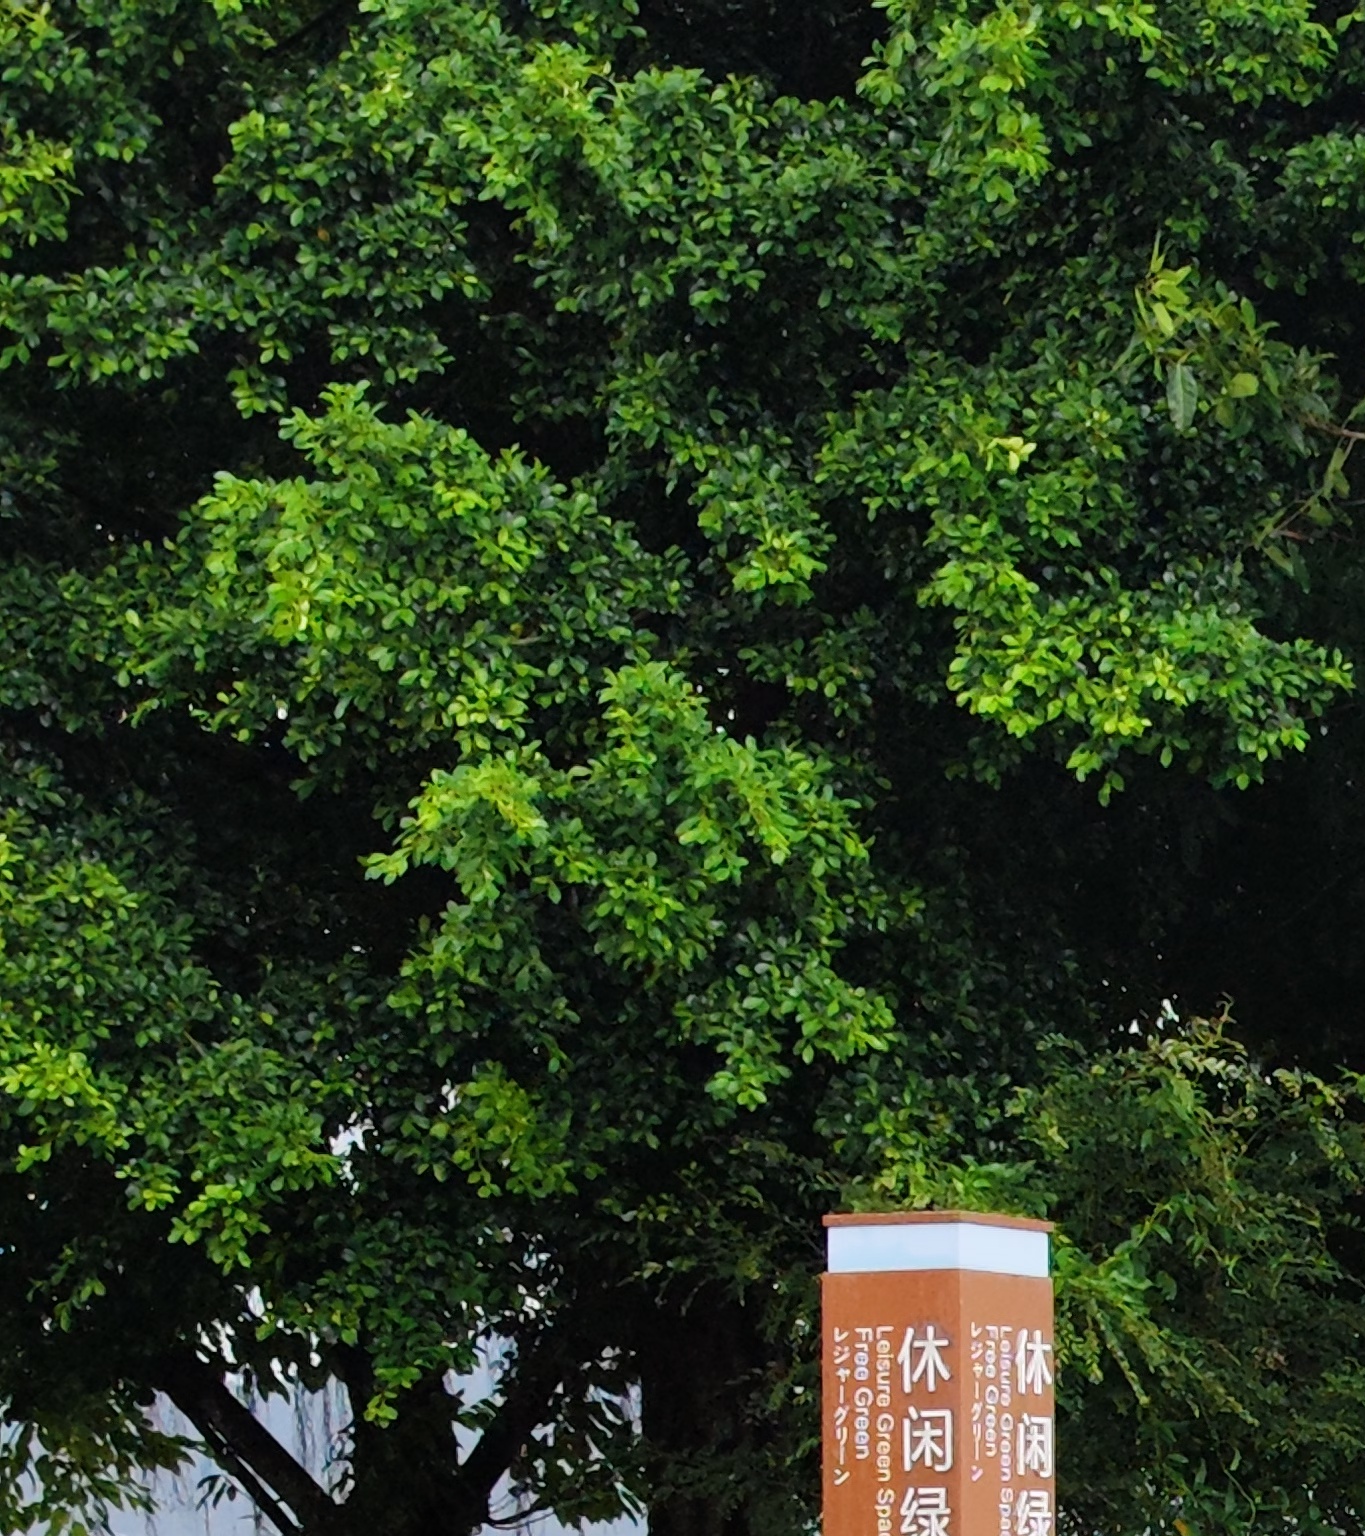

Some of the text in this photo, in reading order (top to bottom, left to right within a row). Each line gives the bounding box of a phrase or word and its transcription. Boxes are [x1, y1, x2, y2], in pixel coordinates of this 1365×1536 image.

[834, 1326, 851, 1486] レジャーグリーン
[854, 1326, 874, 1460] Free Green
[876, 1325, 895, 1407] Leisure
[1000, 1325, 1014, 1407] Leisure
[876, 1413, 895, 1482] Green
[985, 1385, 999, 1458] Green
[1000, 1412, 1014, 1482] Green
